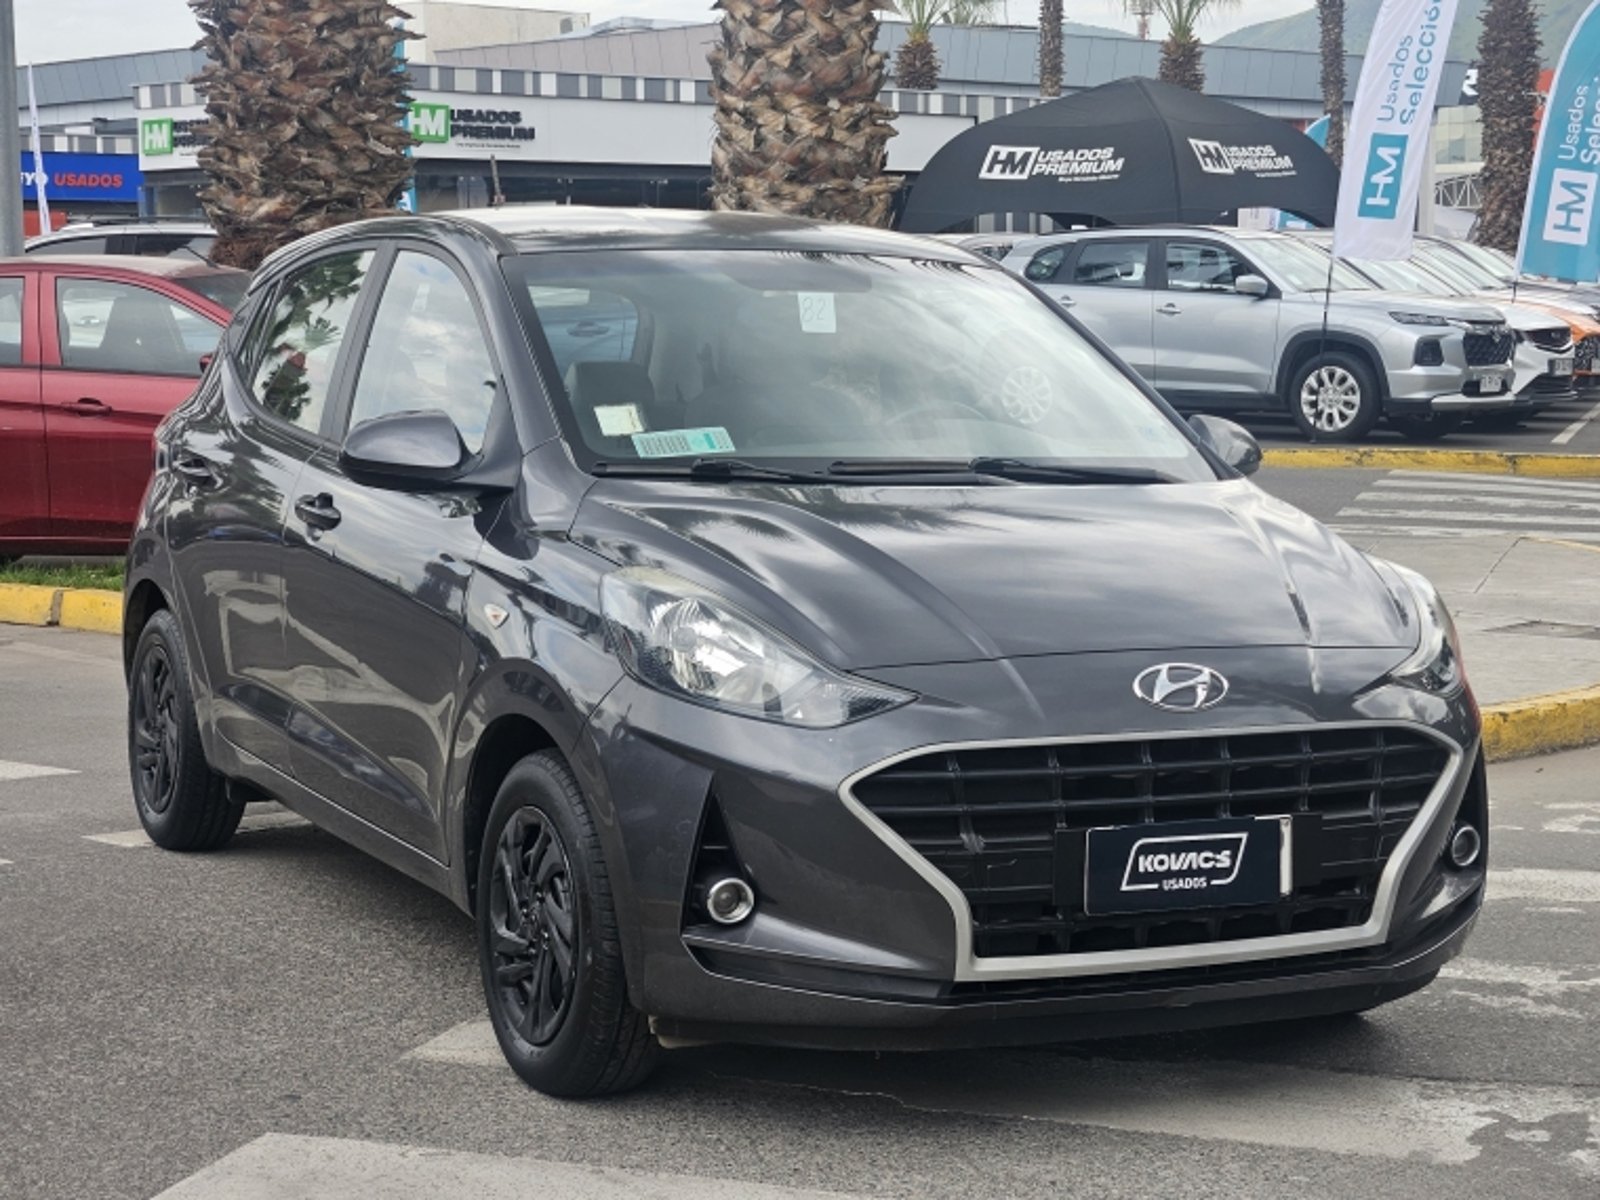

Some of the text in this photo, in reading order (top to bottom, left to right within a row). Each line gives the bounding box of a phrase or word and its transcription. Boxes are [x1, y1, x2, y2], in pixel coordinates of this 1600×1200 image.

[1399, 0, 1441, 125] Selecció
[1377, 34, 1414, 121] Usados
[408, 108, 446, 137] HM
[450, 109, 521, 124] USADOS
[1557, 84, 1589, 160] Usados
[144, 123, 168, 150] HM
[450, 124, 535, 140] PREMIUM
[983, 148, 1035, 176] HM
[1031, 158, 1125, 175] PREMIUM
[1038, 147, 1114, 162] USADOS
[54, 173, 123, 188] USADOS
[1365, 147, 1401, 206] HM
[1552, 180, 1589, 233] HM
[1138, 850, 1232, 872] KOVACS
[1162, 877, 1207, 890] USADOS
